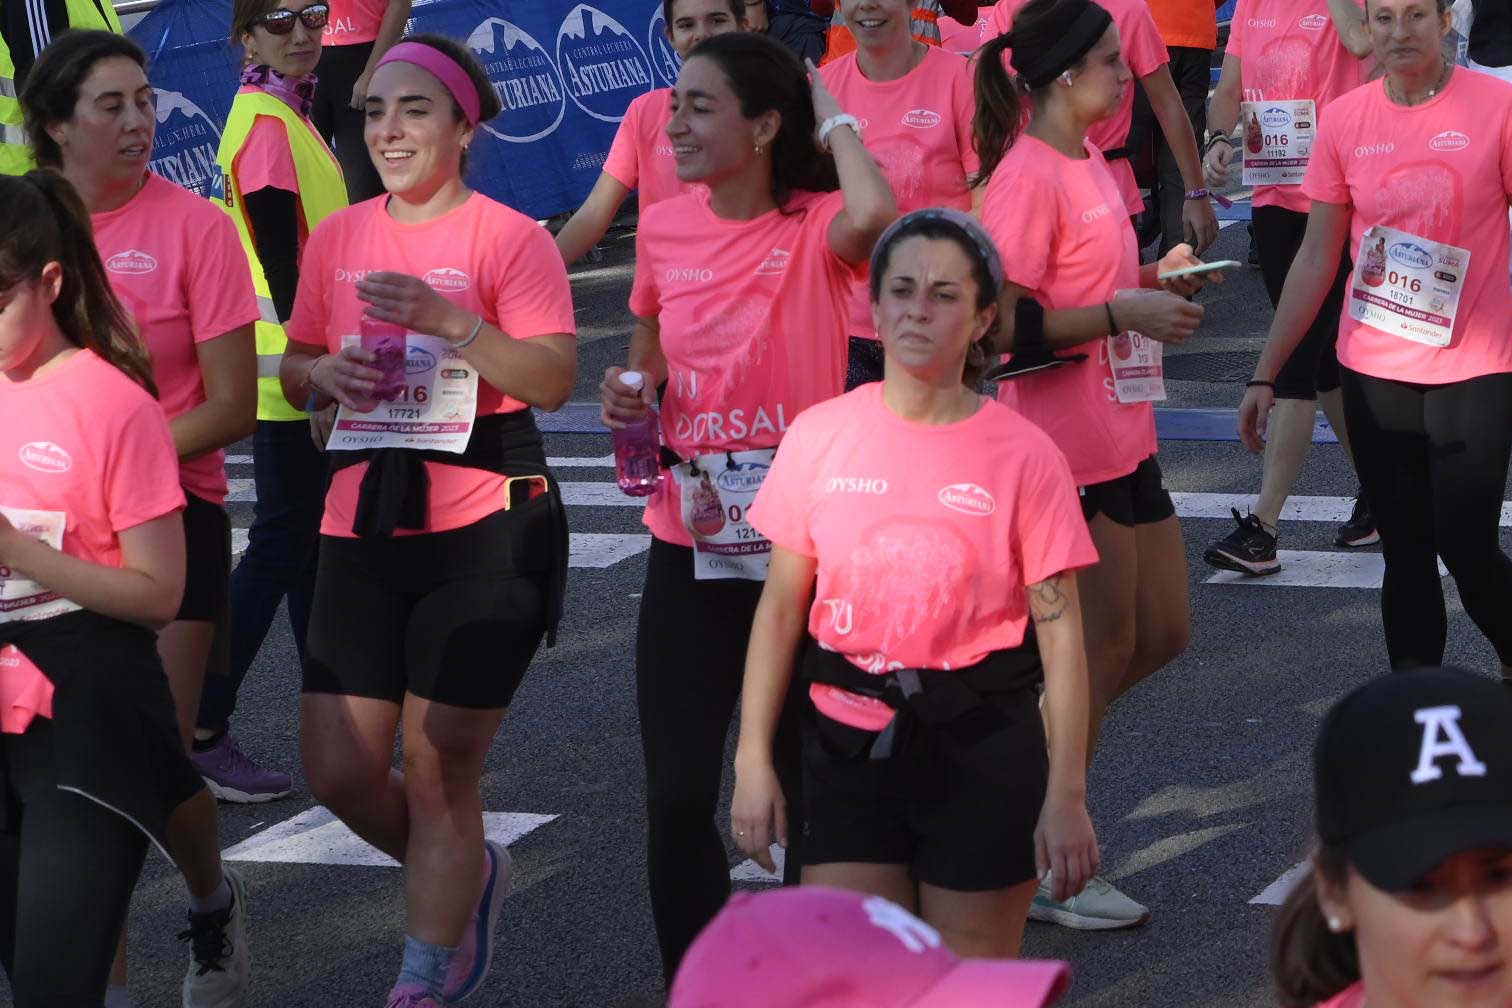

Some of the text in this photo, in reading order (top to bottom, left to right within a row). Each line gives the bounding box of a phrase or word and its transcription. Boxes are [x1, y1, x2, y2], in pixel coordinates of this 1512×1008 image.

[1247, 18, 1276, 29] OYSHO
[573, 40, 633, 59] CENTRAL LECHERA
[512, 53, 545, 71] LECHERA
[564, 52, 650, 98] ASTURIANA
[498, 72, 562, 112] TURIANA
[1264, 134, 1289, 147] 016
[1267, 149, 1287, 157] 11192
[1355, 143, 1394, 158] OYSHO
[1391, 246, 1429, 267] ASTURIANA
[666, 267, 714, 282] OYSHO
[1388, 271, 1422, 293] 016
[1389, 289, 1414, 305] 18701
[1358, 304, 1387, 322] OYSHO
[1363, 293, 1389, 310] CARRERA
[1405, 307, 1427, 321] MUJER
[1407, 324, 1442, 338] Santander
[388, 408, 420, 419] 17721
[1410, 704, 1488, 785] A
